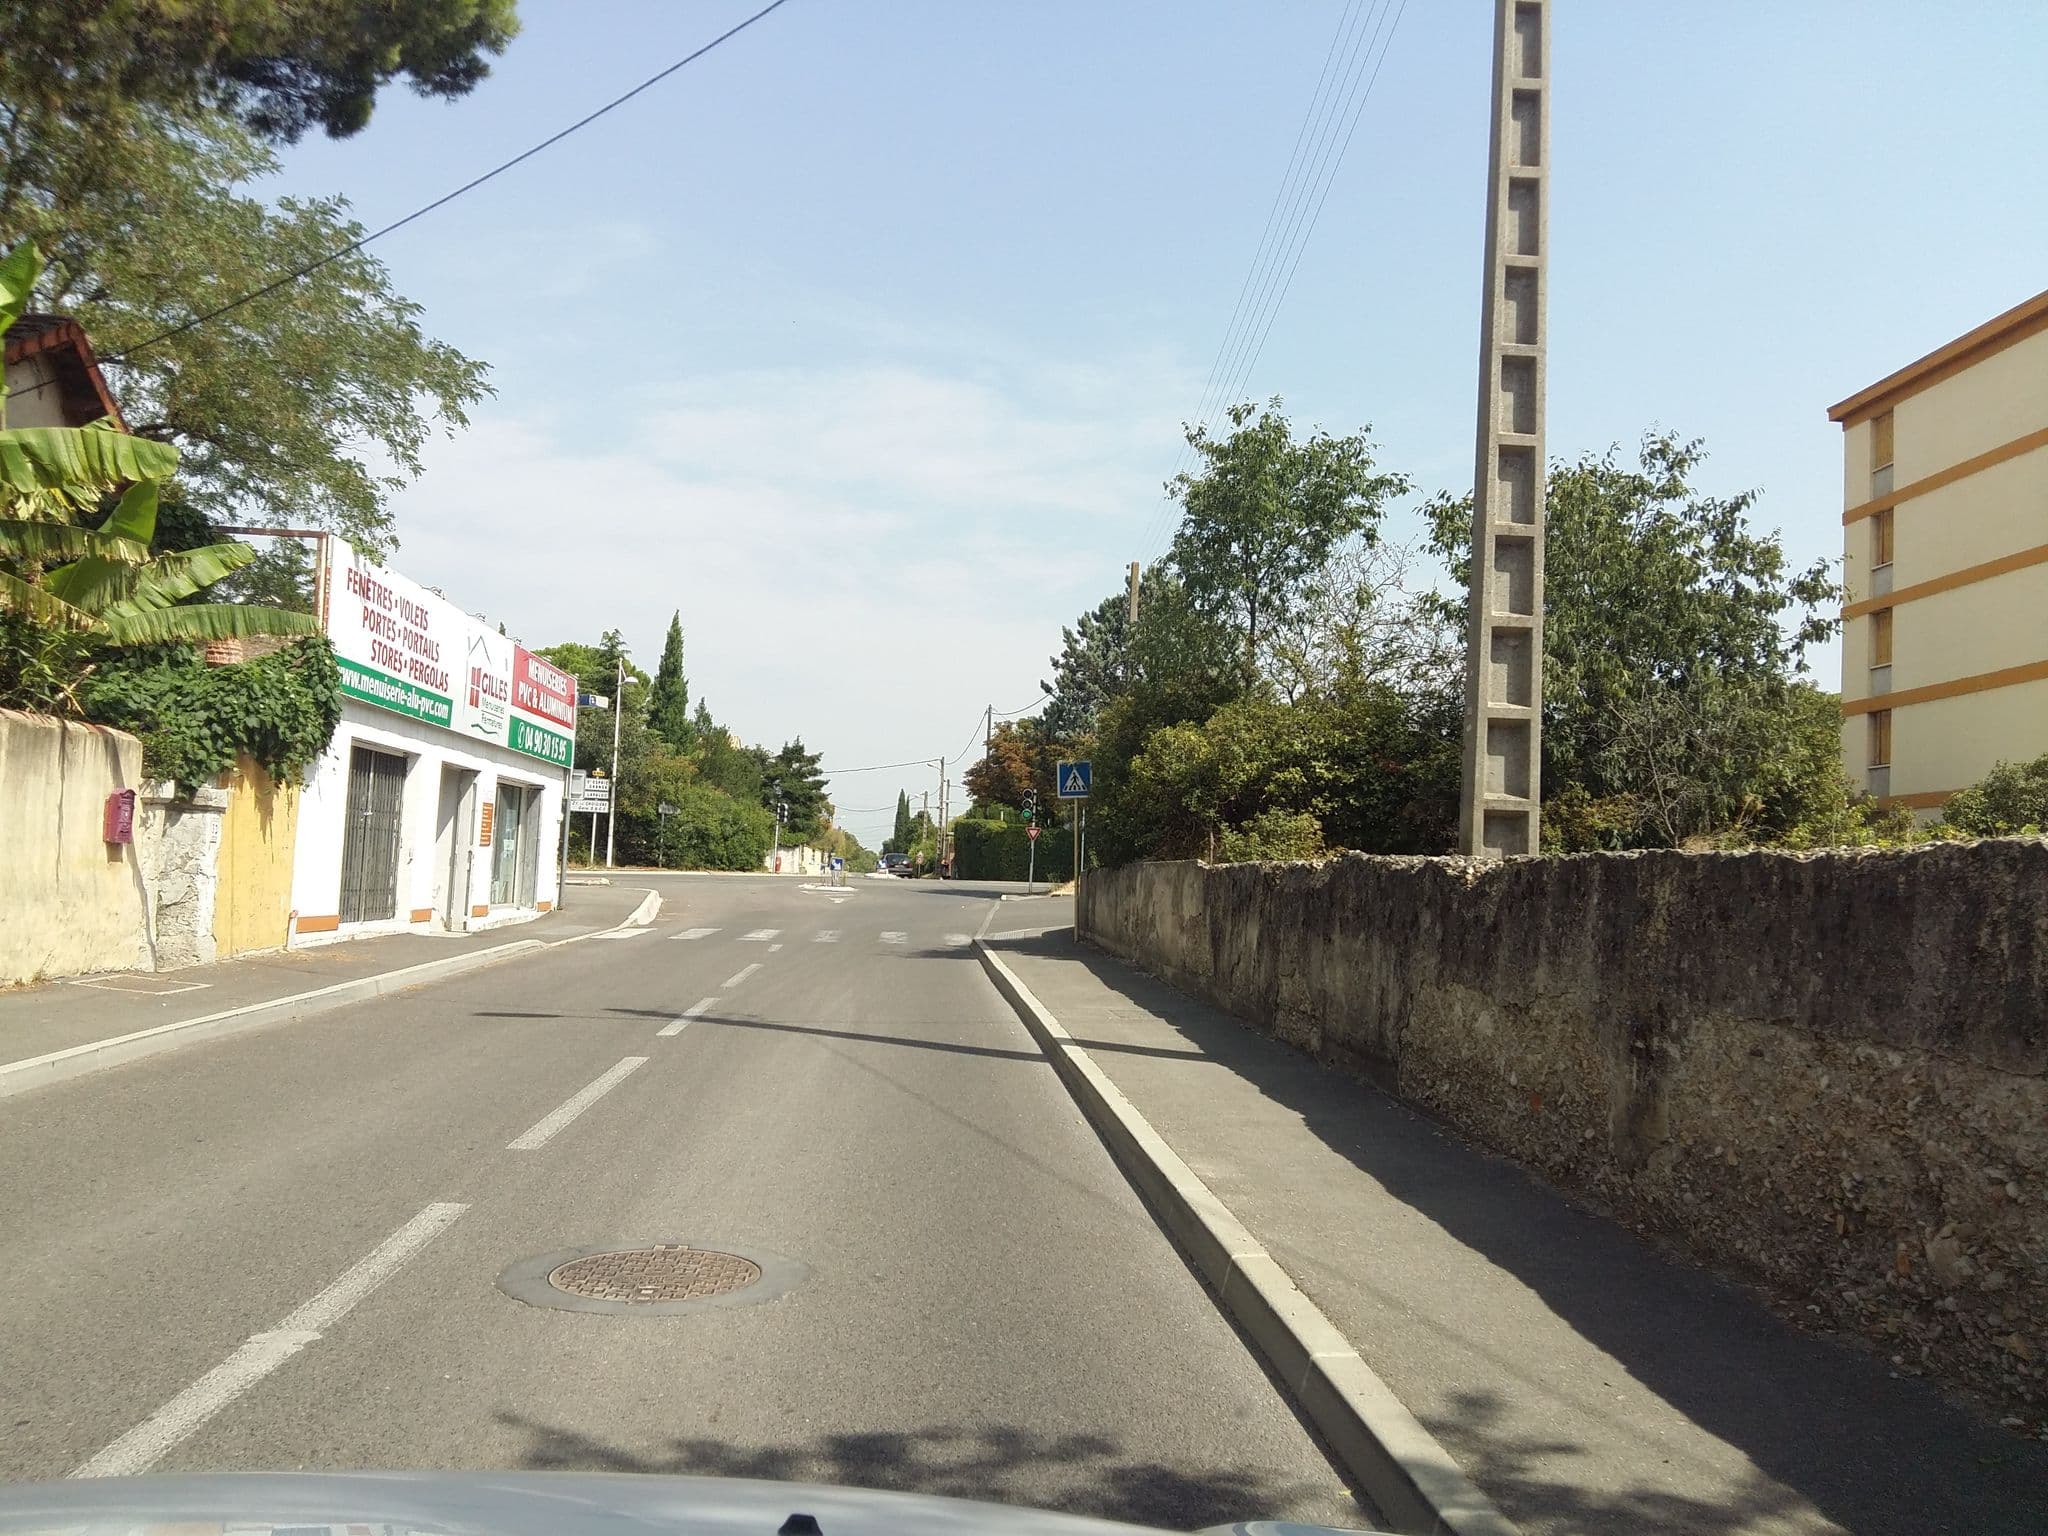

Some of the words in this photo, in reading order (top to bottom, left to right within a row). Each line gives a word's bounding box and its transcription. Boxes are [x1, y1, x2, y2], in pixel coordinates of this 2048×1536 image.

[346, 567, 393, 613] FENÊTRES
[399, 595, 429, 631] VOLETS
[362, 605, 397, 643] PORTES
[402, 626, 440, 663] PORTAILS
[370, 639, 403, 673] STORES
[408, 657, 449, 692] PERGOLAS
[481, 672, 508, 702] GILLES
[528, 658, 567, 697] MENUISERIES
[518, 680, 532, 707] PVC
[532, 688, 538, 709] &
[538, 691, 573, 723] ALUMINIUM
[525, 727, 533, 750] 04
[534, 733, 542, 753] 90
[542, 735, 550, 757] 30
[551, 739, 559, 759] 15
[559, 741, 566, 762] 95
